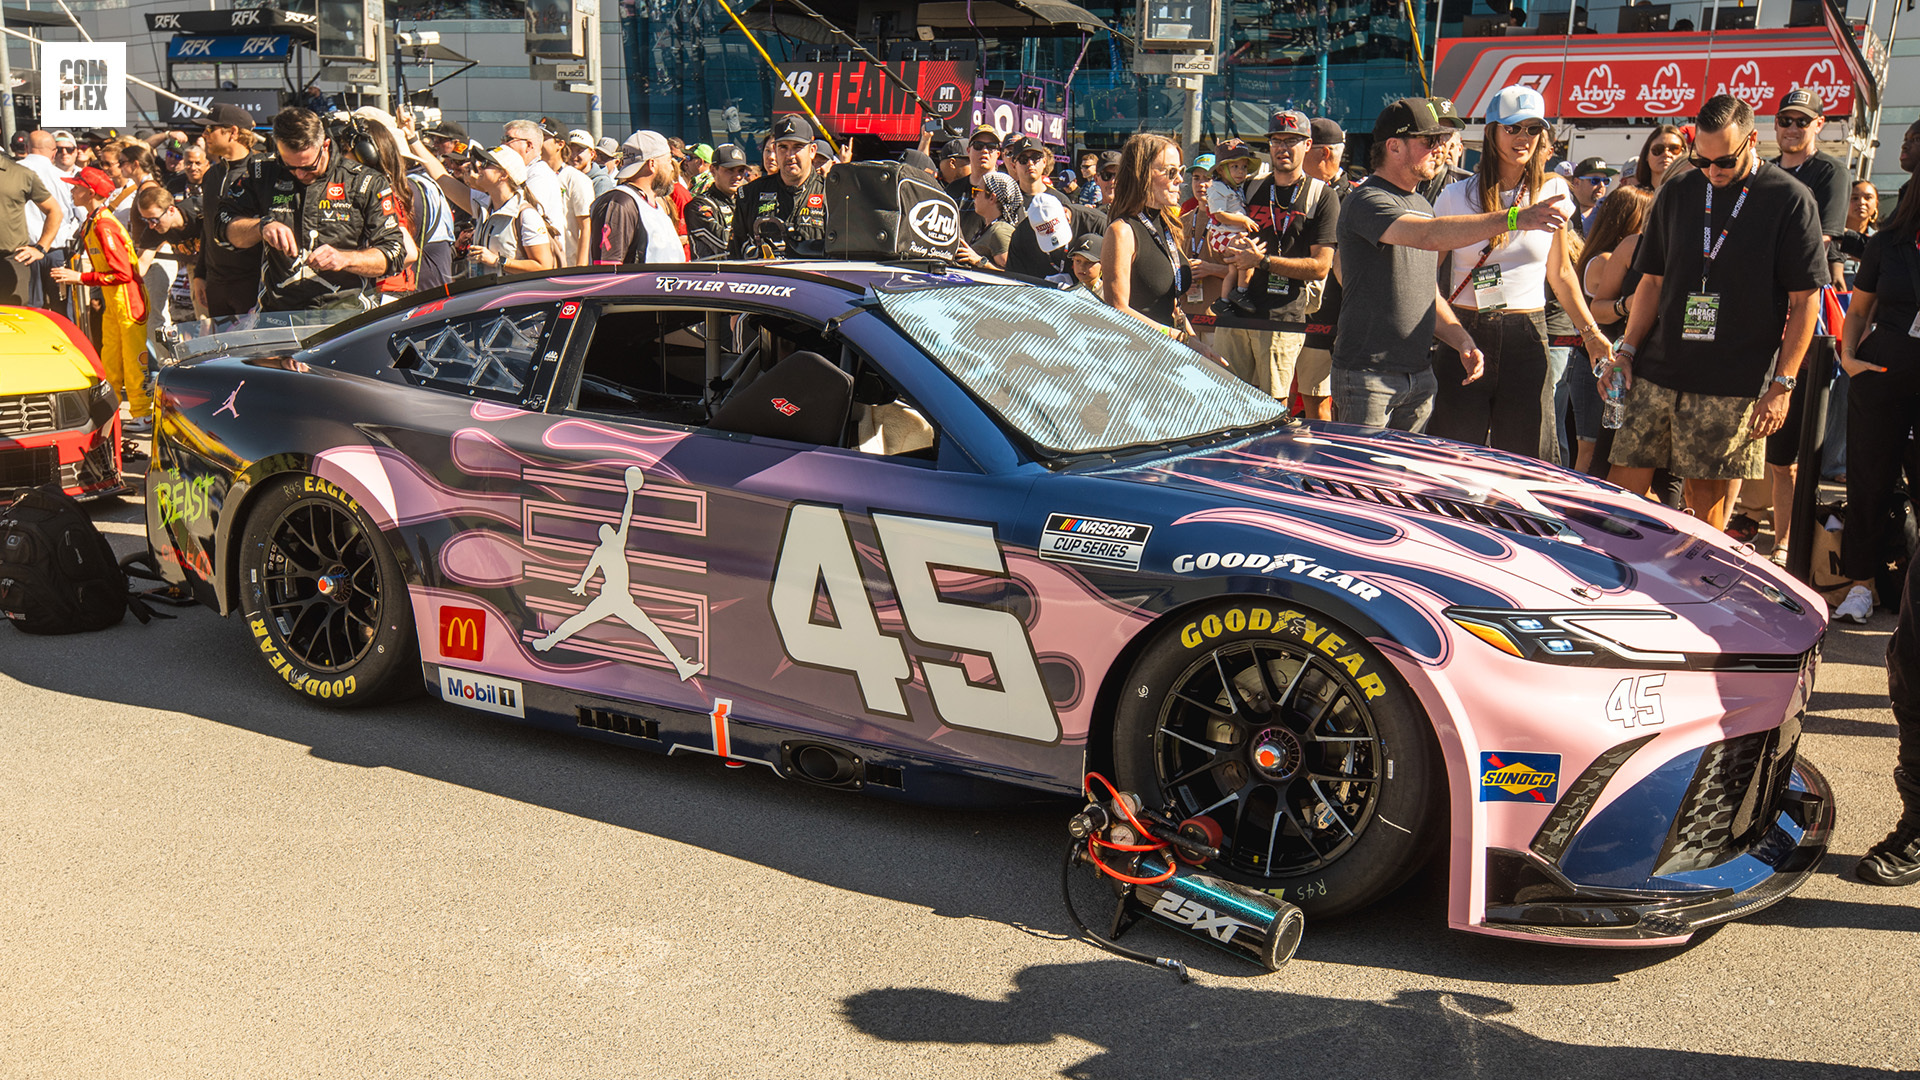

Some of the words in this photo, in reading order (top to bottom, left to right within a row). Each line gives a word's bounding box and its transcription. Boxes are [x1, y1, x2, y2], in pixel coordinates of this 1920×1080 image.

[155, 14, 181, 29] RFK
[231, 10, 260, 26] RFK
[178, 39, 216, 56] RFK
[240, 36, 280, 54] RFK
[780, 71, 812, 98] 48
[818, 60, 922, 115] TEAM
[939, 86, 955, 100] PIT
[1569, 82, 1626, 102] Arby's
[1636, 81, 1696, 102] Arby's
[1714, 80, 1774, 101] Arby's
[937, 103, 954, 113] CREW
[676, 279, 725, 293] TYLER
[726, 281, 797, 298] REDDICK
[770, 396, 801, 417] 45
[153, 472, 216, 530] BEAST
[304, 476, 362, 514] EAGLE
[1076, 519, 1136, 540] NASCAR
[1053, 535, 1088, 554] CUP
[1089, 540, 1129, 560] SERIES
[769, 499, 1063, 748] 45
[447, 677, 497, 705] Mobil
[1605, 672, 1667, 729] 45
[1484, 770, 1553, 789] SUNOCO
[1151, 890, 1241, 944] 23XI
